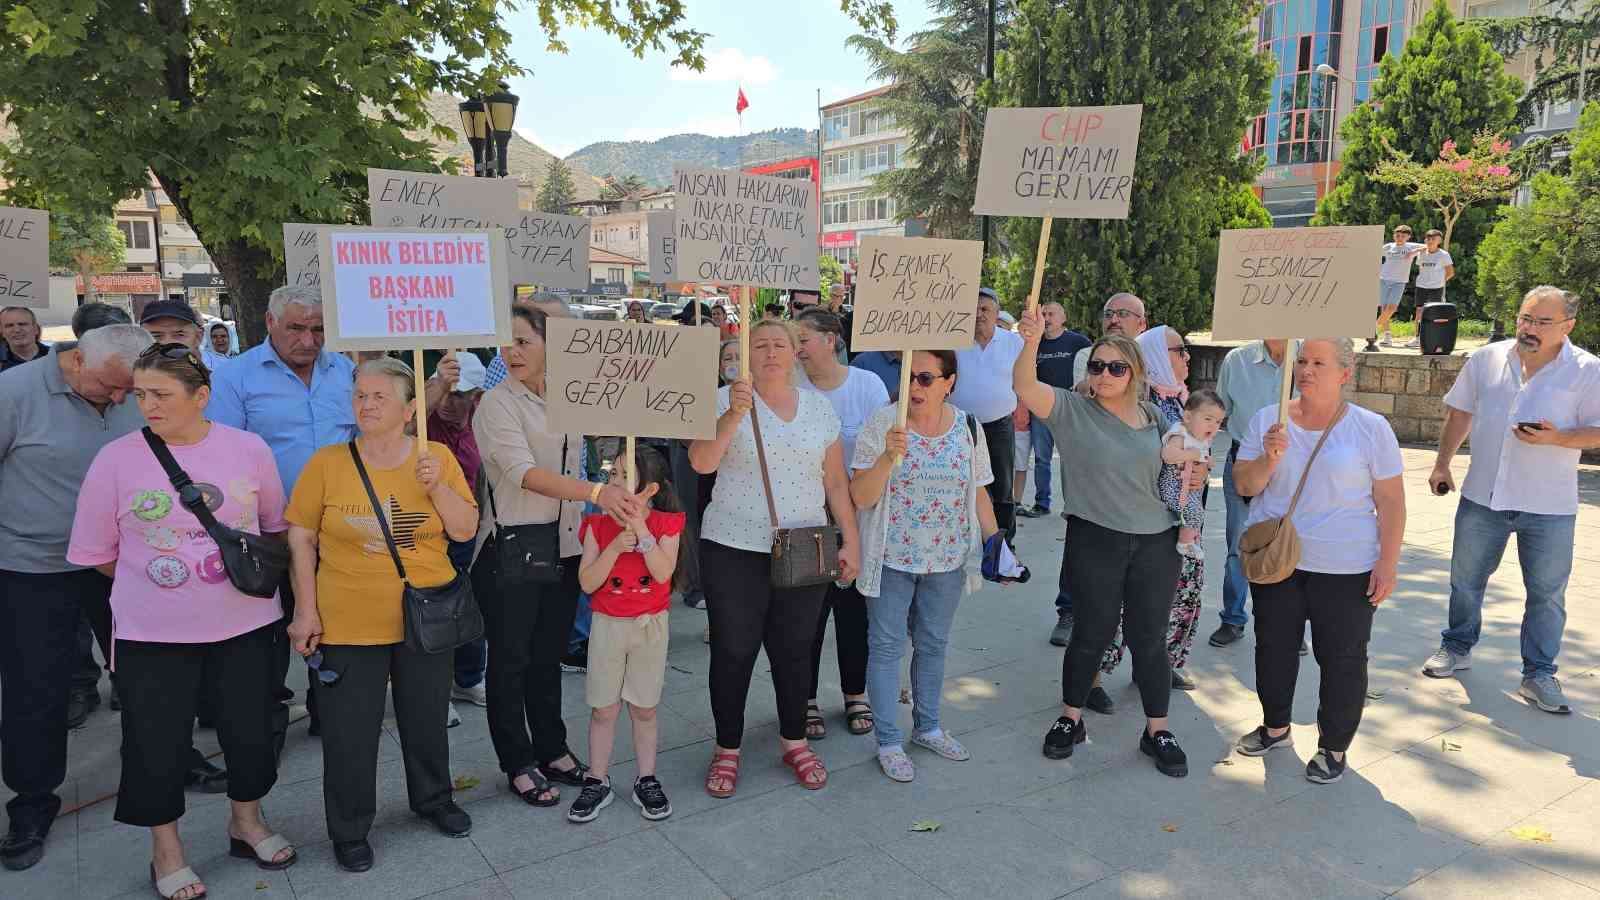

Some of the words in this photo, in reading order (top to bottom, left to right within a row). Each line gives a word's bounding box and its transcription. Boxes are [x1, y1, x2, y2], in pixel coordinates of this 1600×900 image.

[1041, 112, 1104, 144] CHP
[1021, 146, 1120, 174] MAMAMI
[380, 178, 447, 209] EMEK
[737, 175, 809, 209] HAKLARINI
[1088, 175, 1131, 202] VER
[520, 216, 590, 241] AŞKAN
[336, 241, 392, 265] KINIK
[398, 235, 486, 265] BELEDİYE
[520, 244, 576, 273] TİFA
[720, 246, 789, 263] MEYDAN
[369, 275, 455, 305] BAŞKANI
[892, 279, 918, 304] AŞ
[1240, 281, 1339, 308] DUY!!!
[387, 304, 449, 333] İSTİFA
[563, 327, 681, 359] BABAMIN
[565, 379, 629, 411] GERİ
[645, 386, 696, 424] VER.
